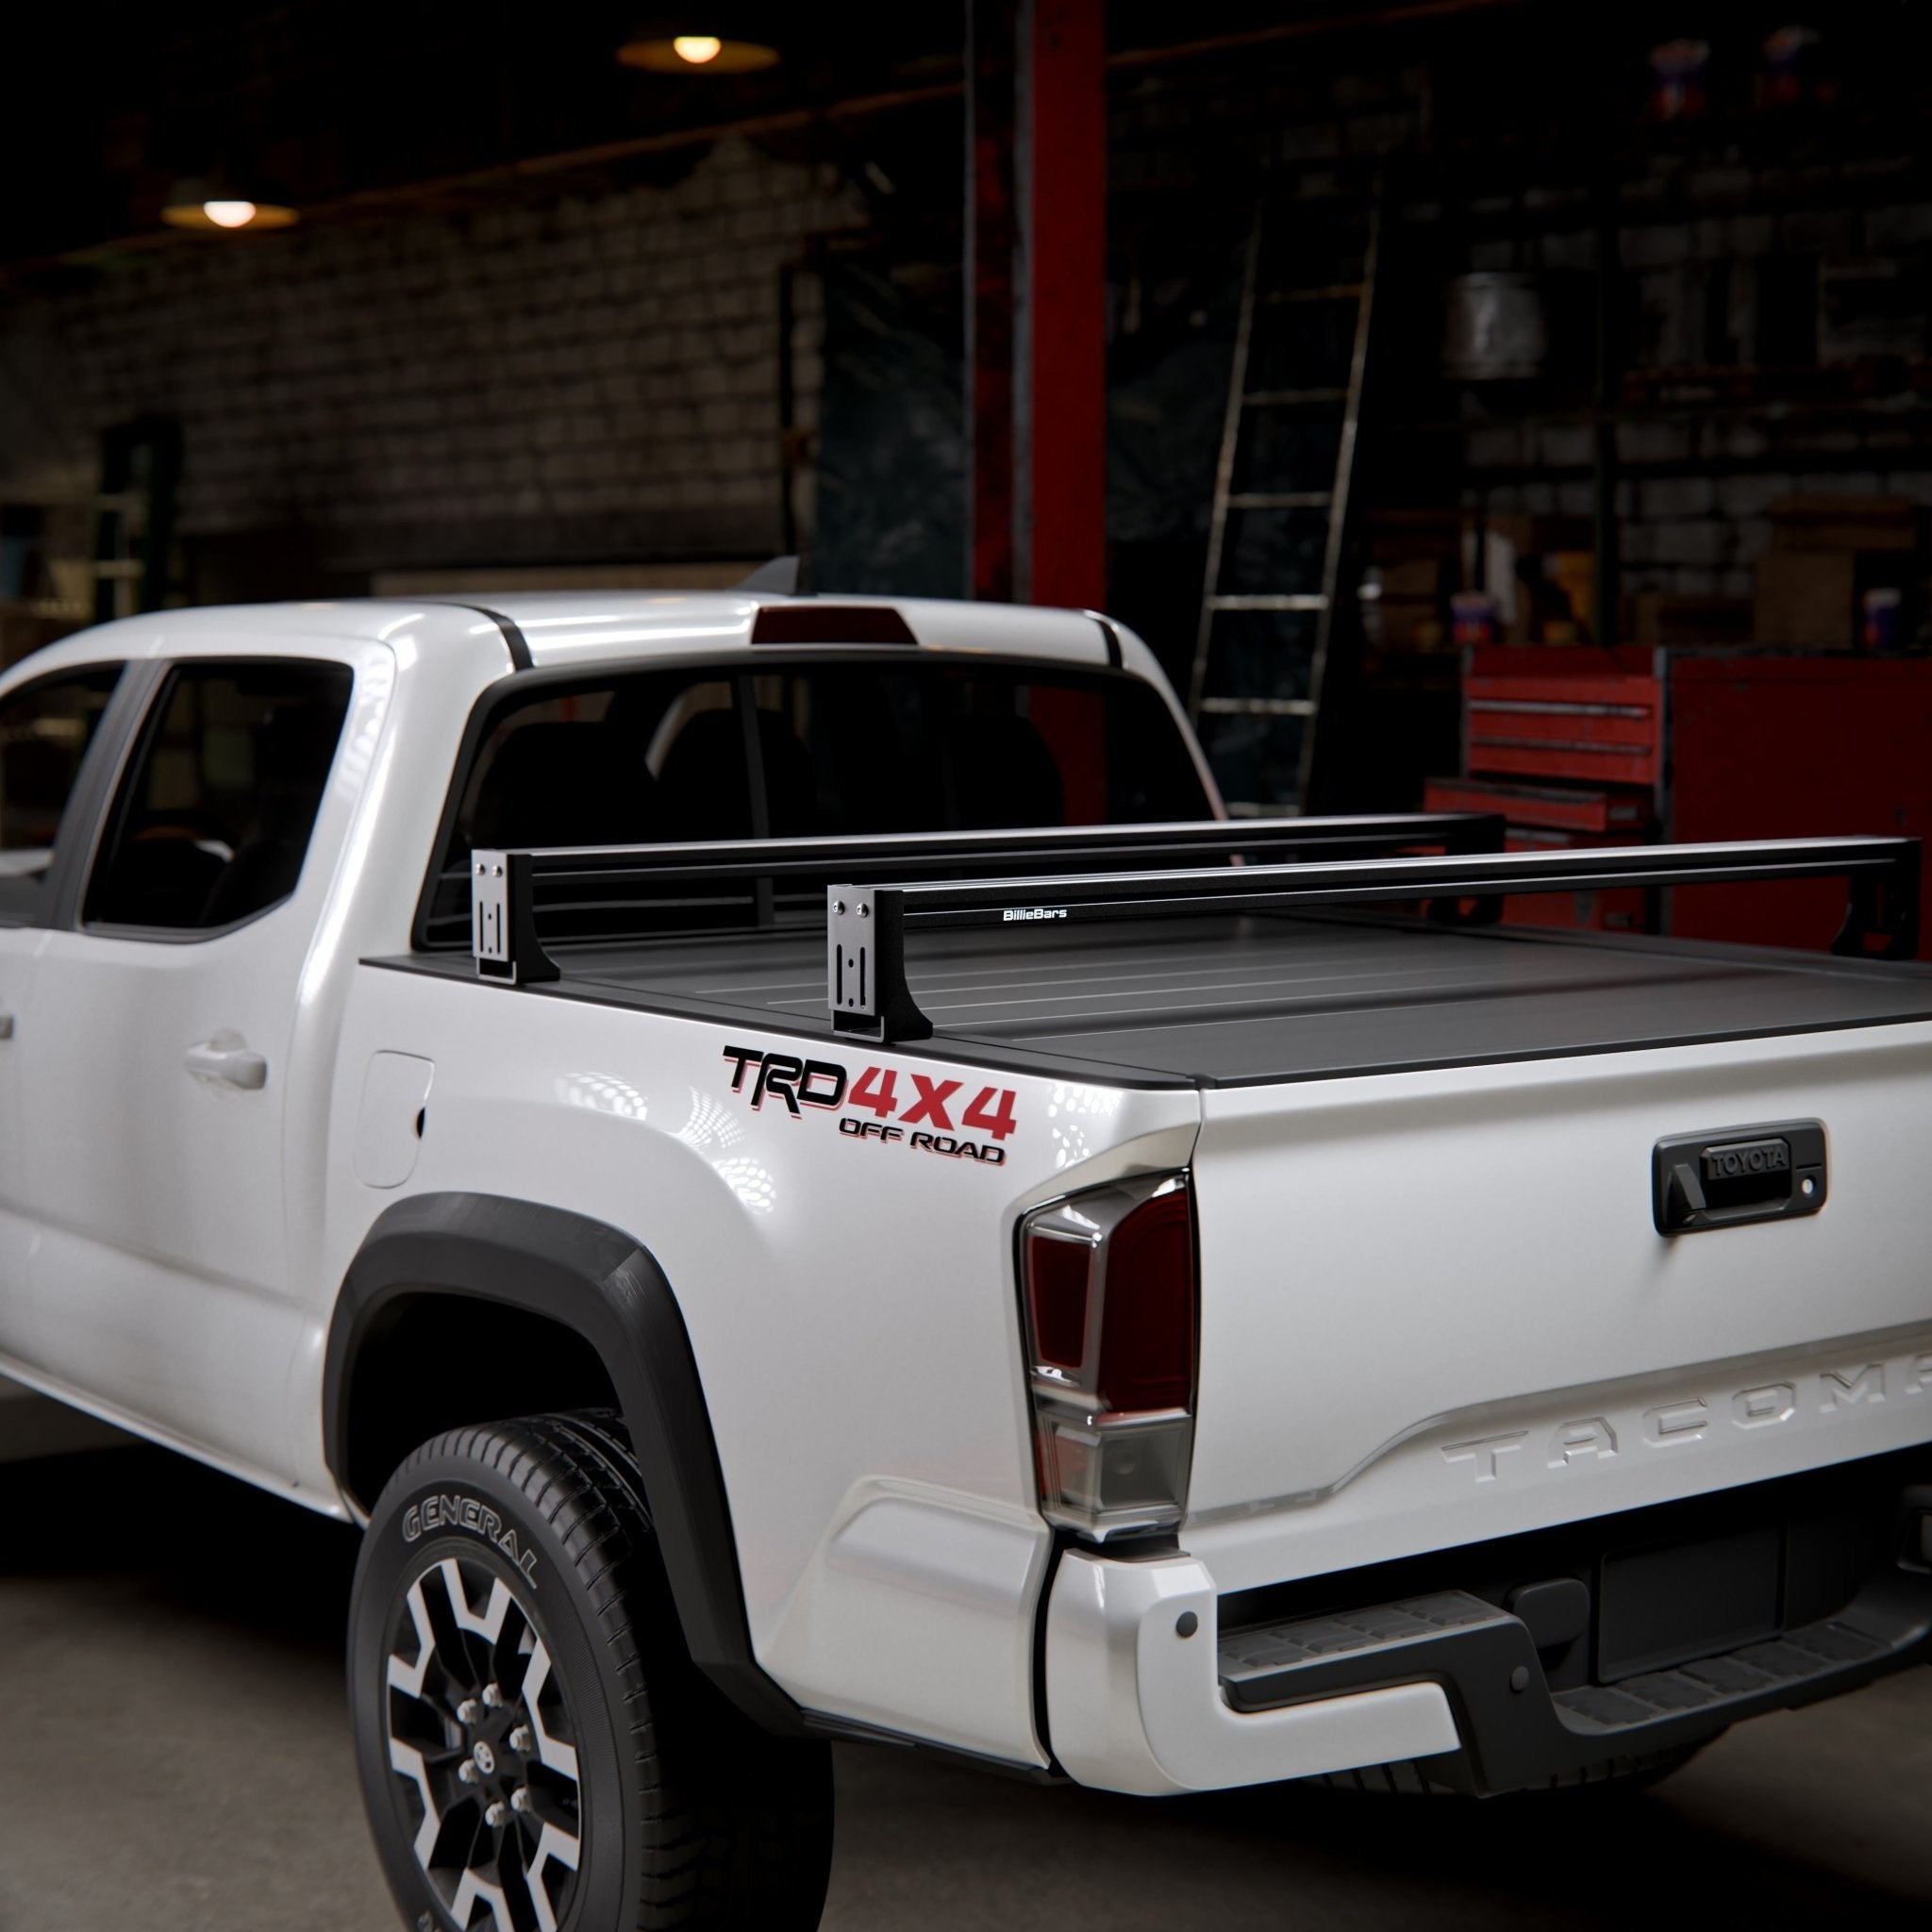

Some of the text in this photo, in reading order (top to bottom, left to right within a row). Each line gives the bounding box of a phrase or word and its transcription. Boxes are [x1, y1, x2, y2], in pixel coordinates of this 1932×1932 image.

[1003, 908, 1067, 921] BillieBars
[723, 1045, 848, 1120] TRD
[839, 1118, 1007, 1166] OFF ROAD
[1711, 1146, 1786, 1176] TOYOTA
[402, 1494, 537, 1590] GENERAL
